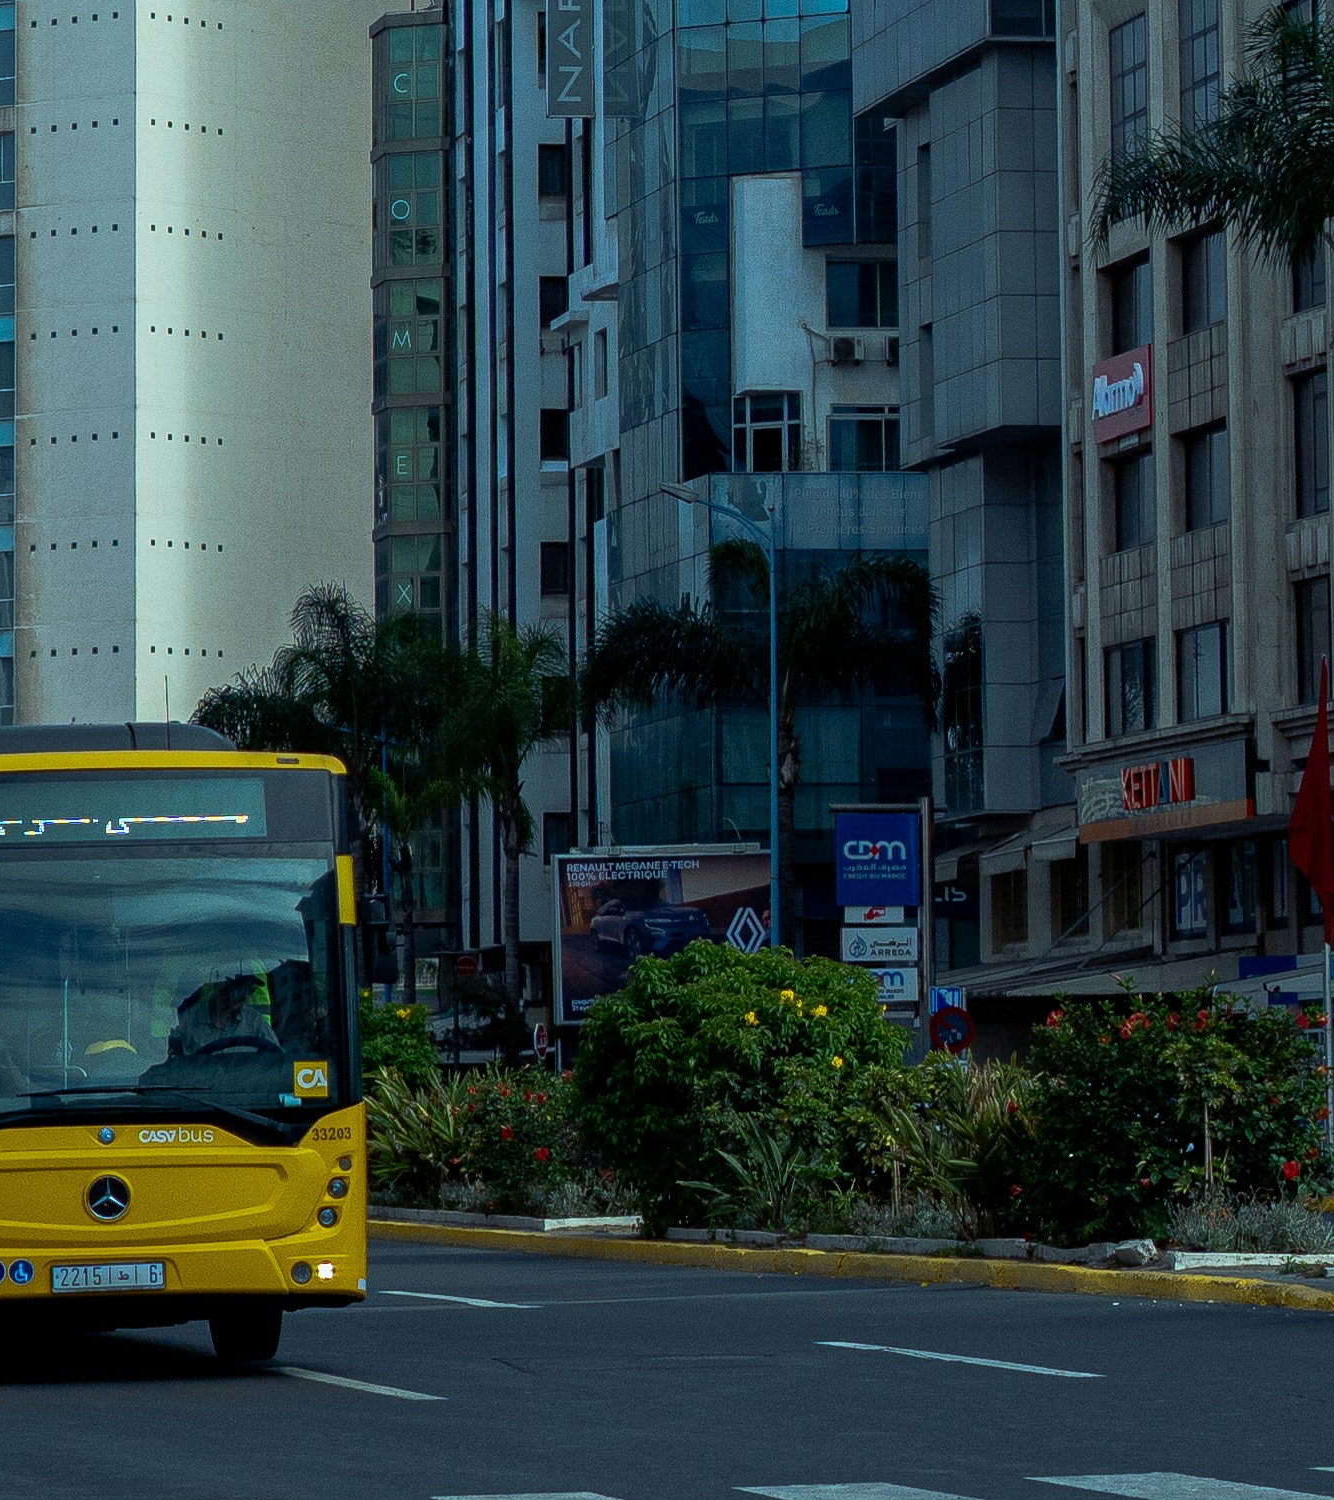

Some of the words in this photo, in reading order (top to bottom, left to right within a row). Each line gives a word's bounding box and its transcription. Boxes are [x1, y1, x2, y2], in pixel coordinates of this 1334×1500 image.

[1121, 757, 1195, 811] KETTANI
[566, 863, 614, 873] RENAULT
[662, 859, 700, 870] E-TECH
[567, 872, 596, 881] 100%
[312, 1127, 352, 1141] 33203
[60, 1266, 102, 1287] 2215
[149, 1265, 158, 1284] 6
